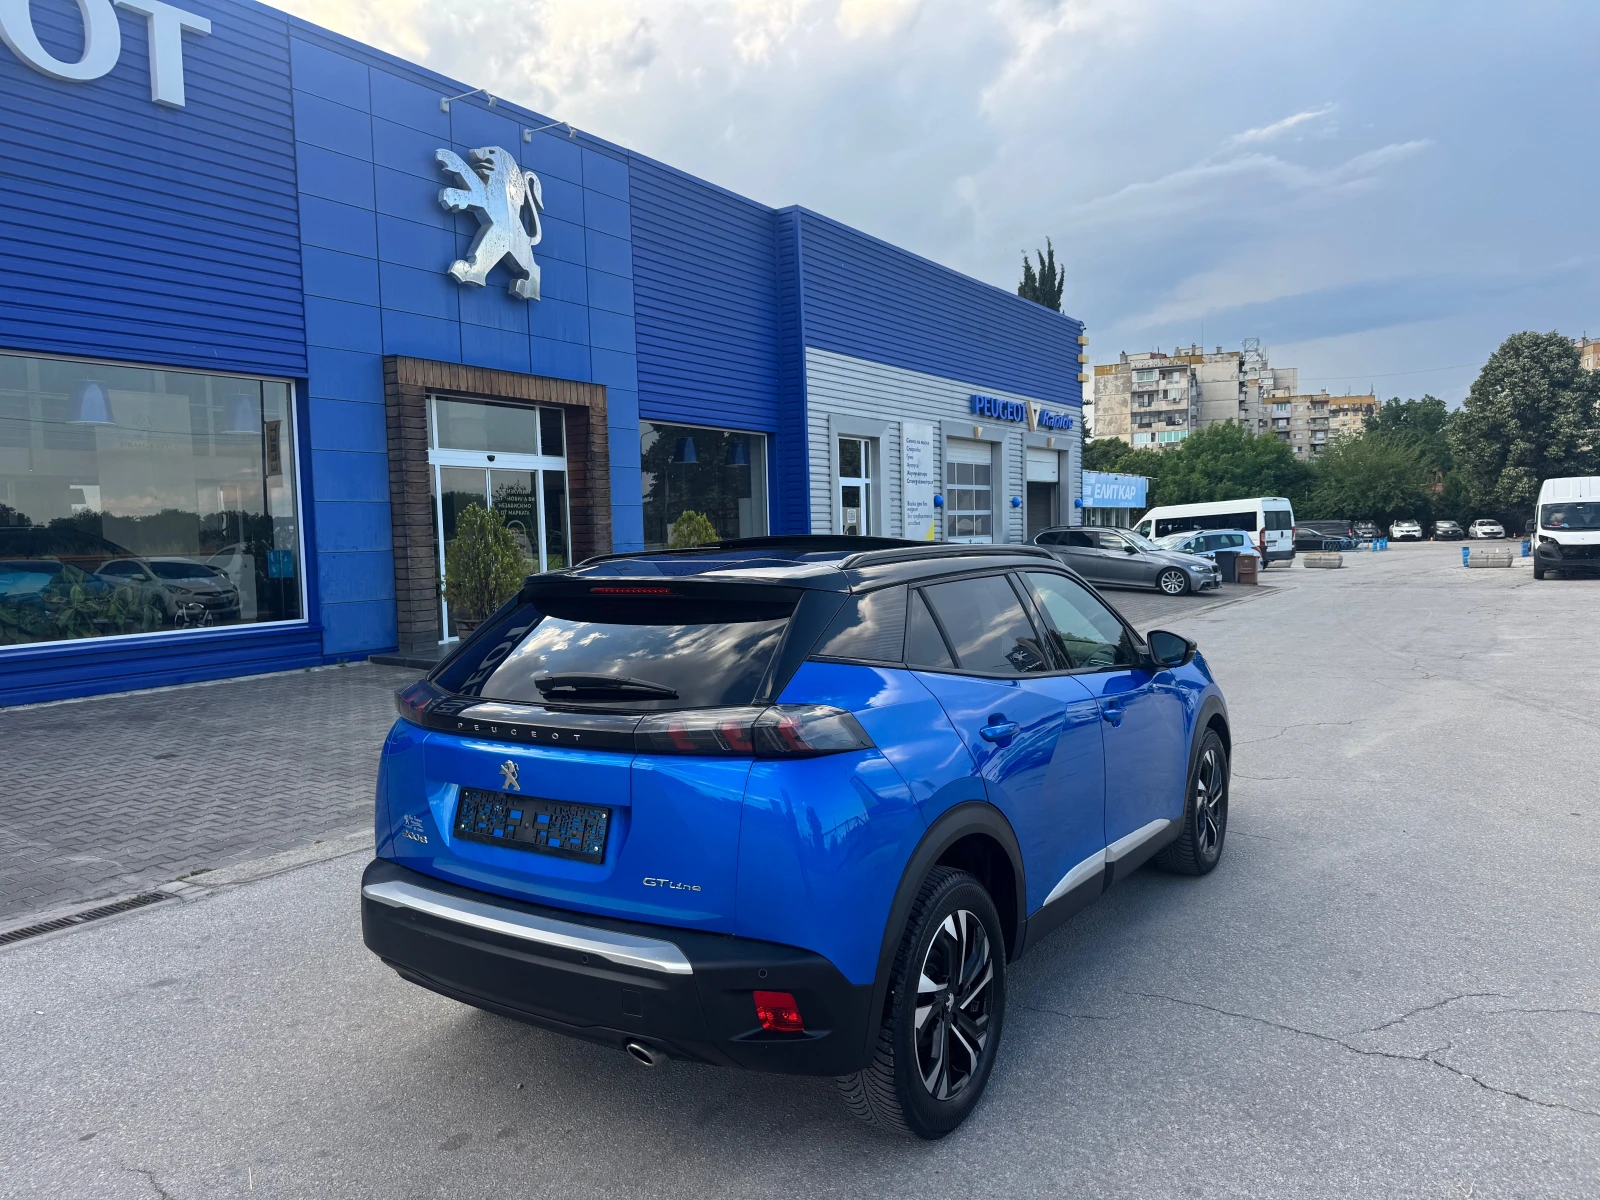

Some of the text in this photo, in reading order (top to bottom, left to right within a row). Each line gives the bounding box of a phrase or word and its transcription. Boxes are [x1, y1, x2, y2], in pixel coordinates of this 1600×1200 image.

[0, 0, 212, 107] OT
[971, 394, 1074, 430] PEUGEOT Rapide
[458, 722, 580, 741] PEUGEOT
